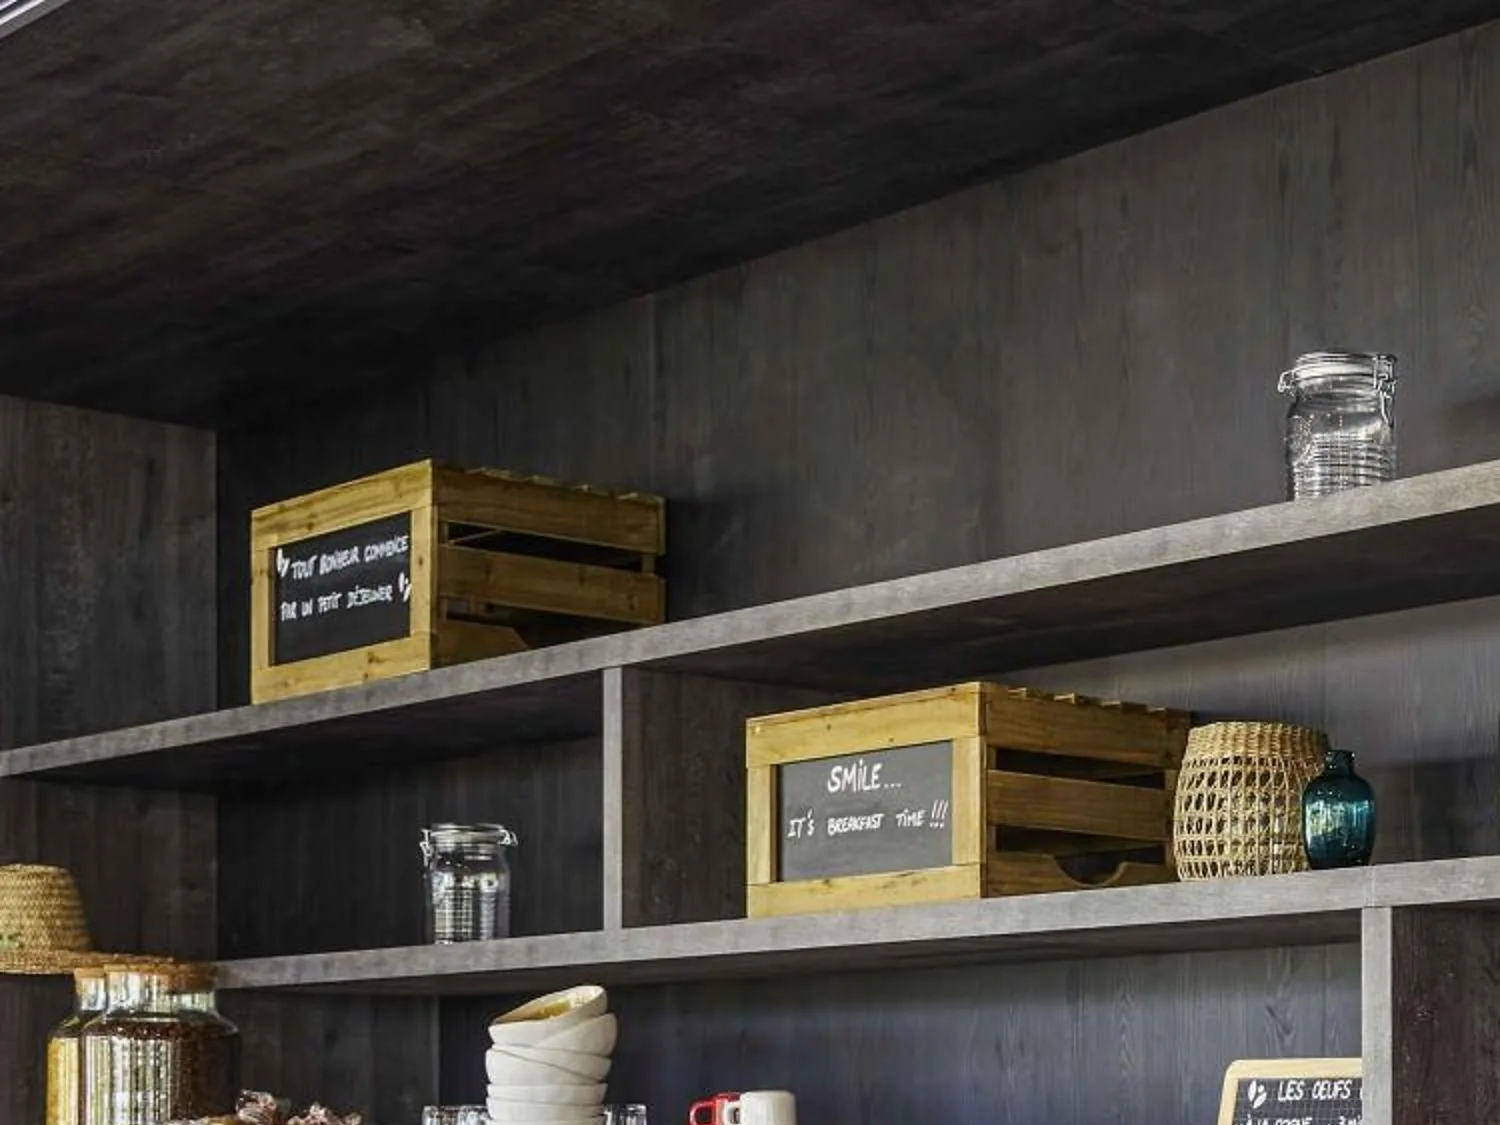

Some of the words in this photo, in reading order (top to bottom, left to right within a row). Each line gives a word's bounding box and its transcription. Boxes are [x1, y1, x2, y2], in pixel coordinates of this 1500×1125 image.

[787, 809, 815, 838] IT'S
[827, 812, 885, 836] BREAKFAST
[1278, 1080, 1305, 1101] LES
